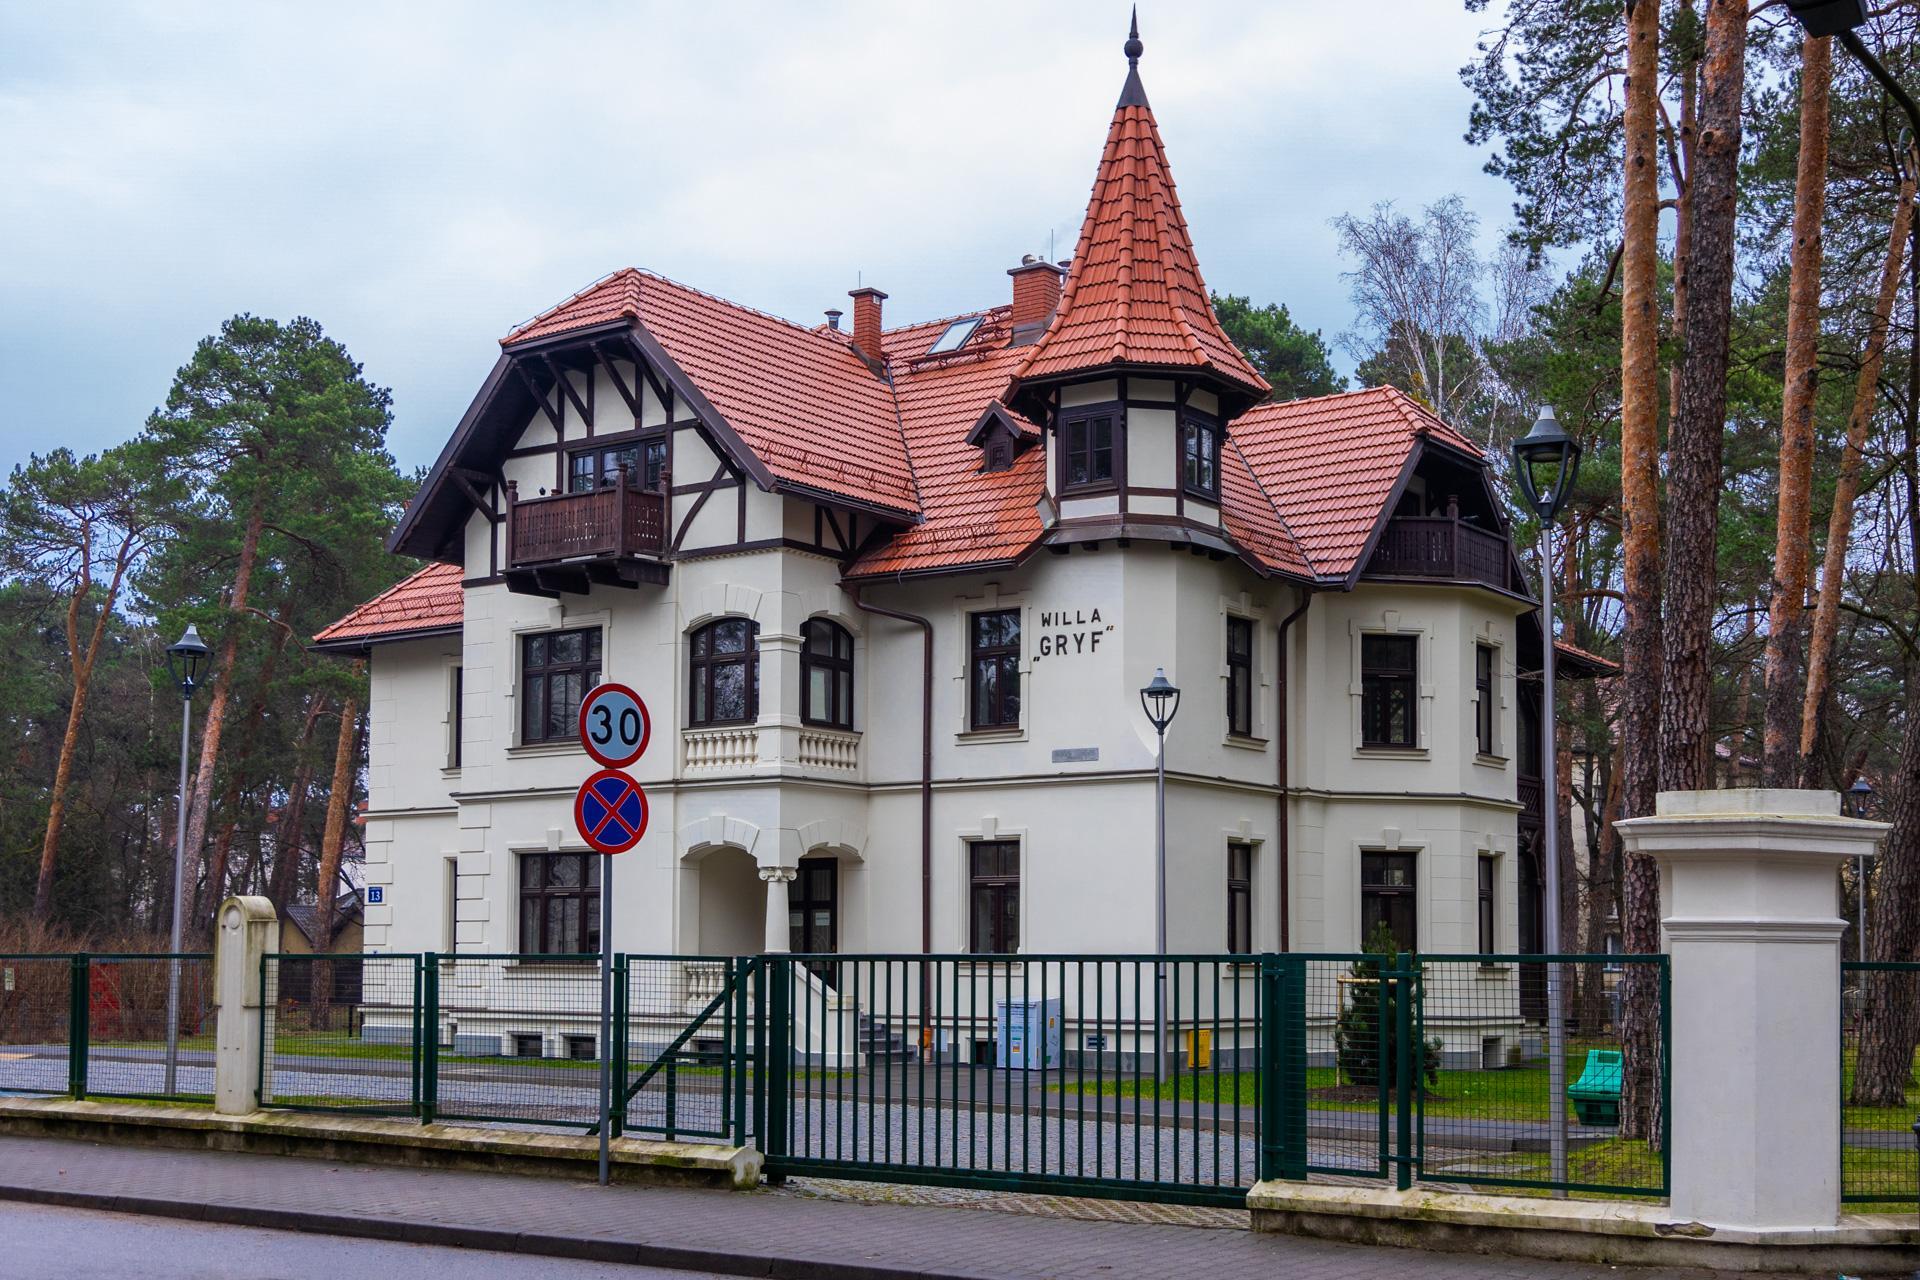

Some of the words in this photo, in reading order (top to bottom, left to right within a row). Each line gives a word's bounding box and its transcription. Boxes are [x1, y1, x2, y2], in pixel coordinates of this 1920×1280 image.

[1041, 608, 1101, 627] WILLA
[591, 704, 641, 746] 30
[370, 891, 381, 901] 13
